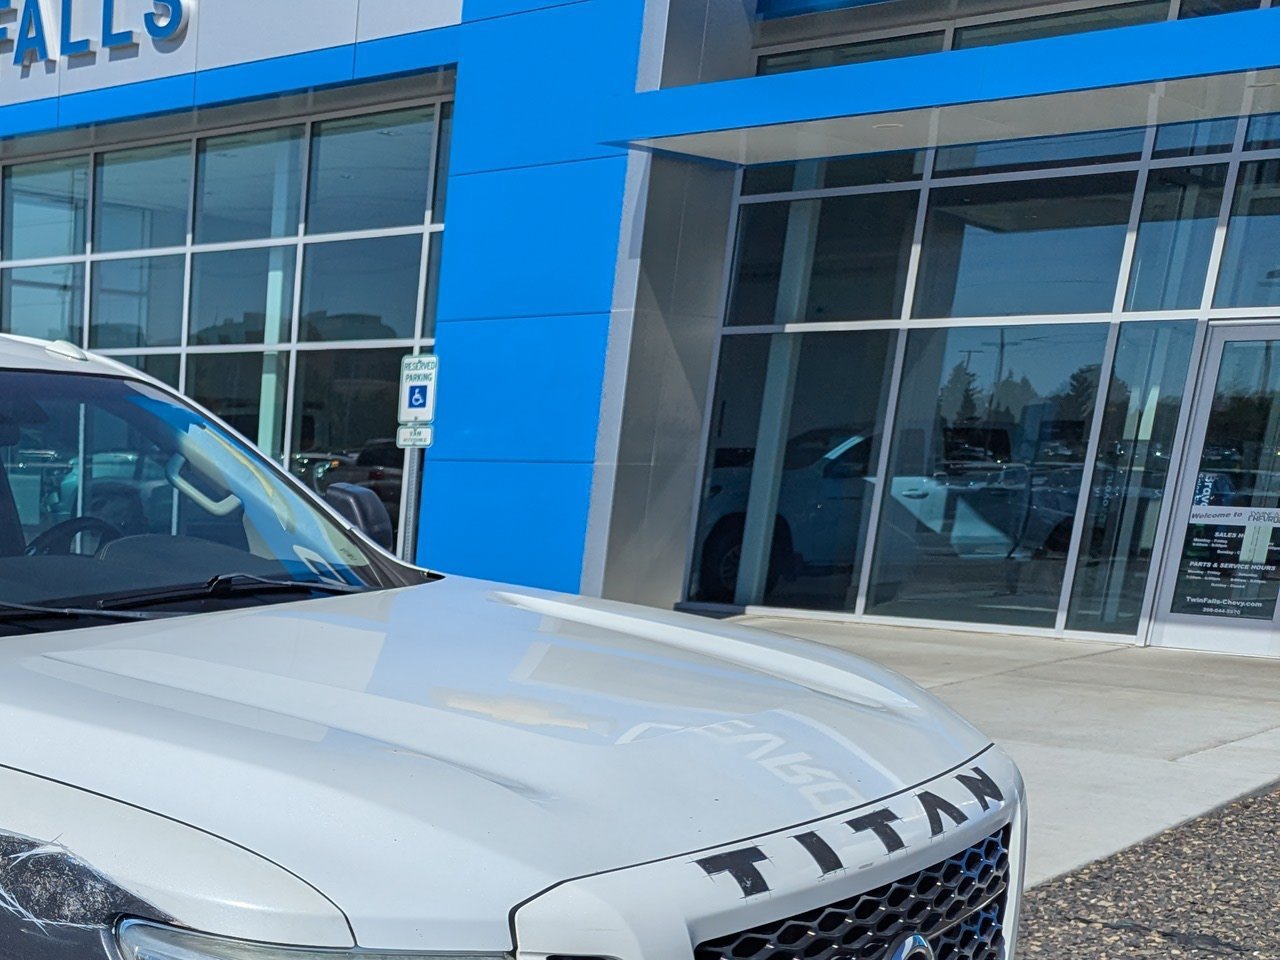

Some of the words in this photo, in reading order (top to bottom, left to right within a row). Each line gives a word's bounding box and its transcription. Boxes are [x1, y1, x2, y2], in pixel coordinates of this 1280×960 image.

[405, 362, 435, 371] RESERVED
[406, 373, 433, 382] PARKING
[1191, 511, 1231, 519] Welcome
[1219, 562, 1250, 571] SERVICE
[1186, 596, 1263, 608] TwinFalls-Chevy.com
[690, 766, 1005, 899] TITAN
